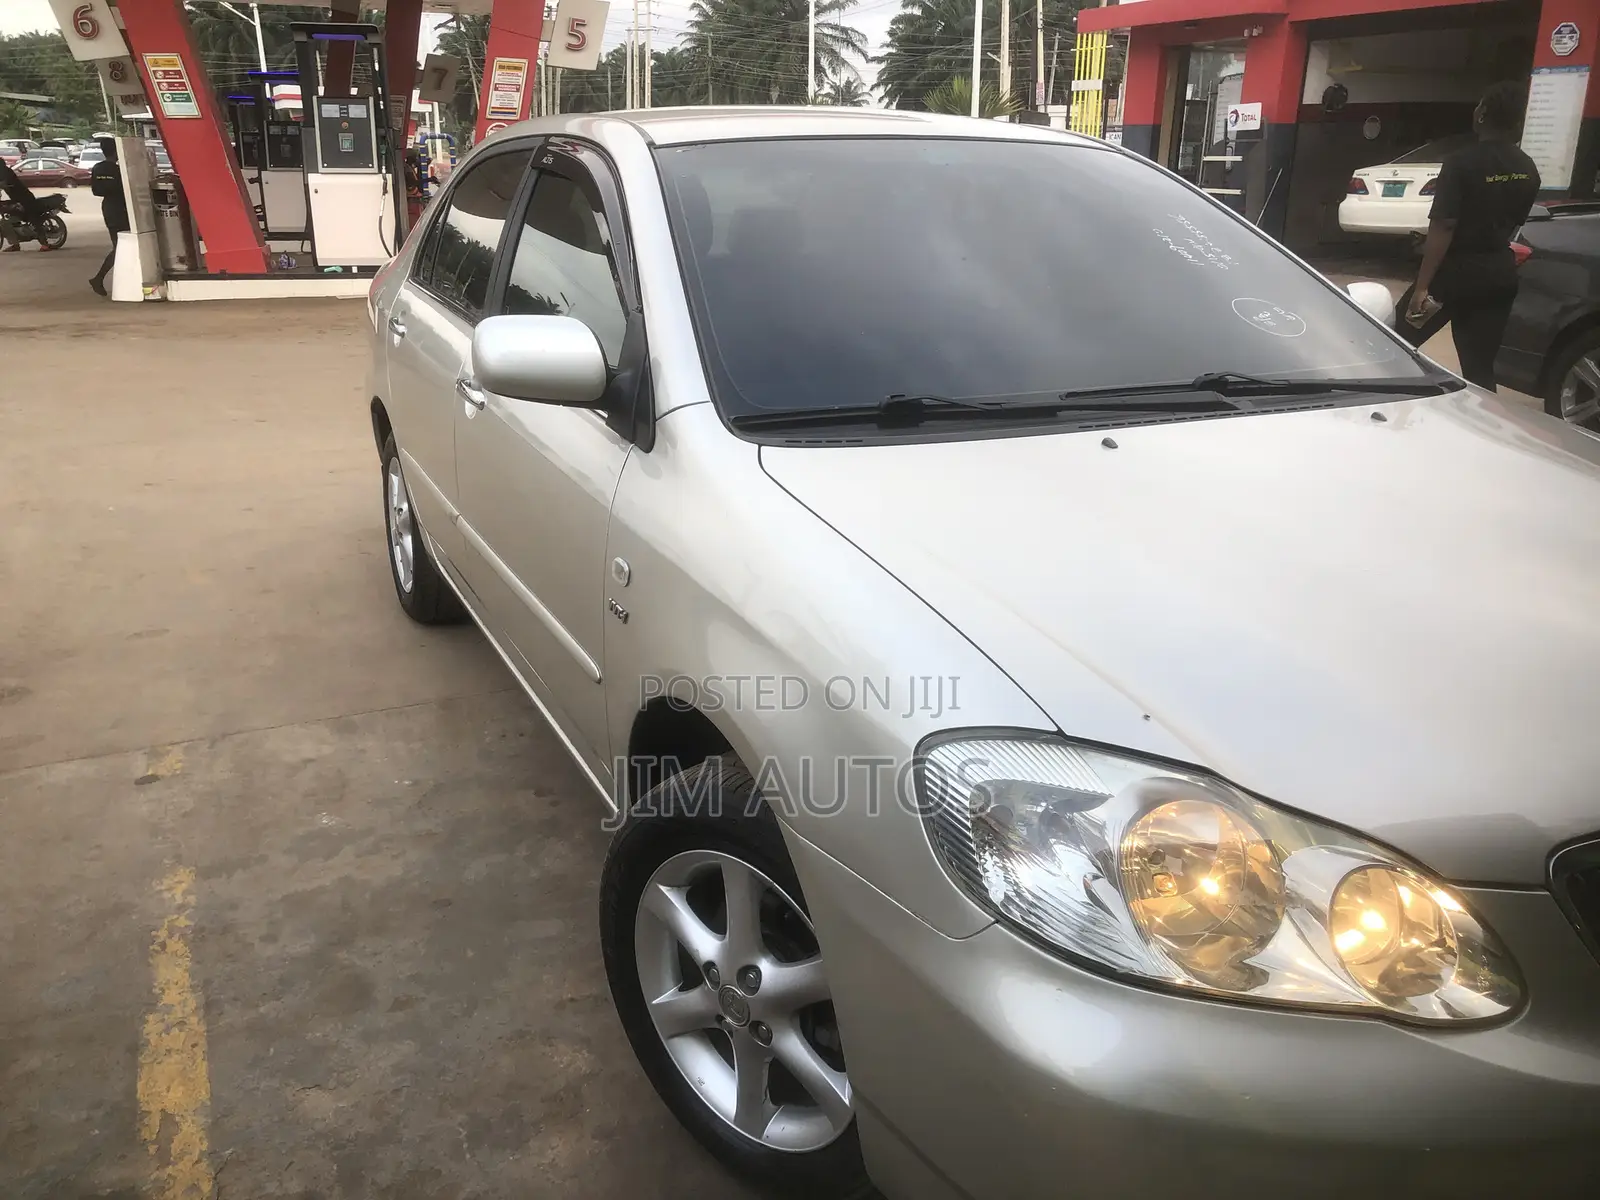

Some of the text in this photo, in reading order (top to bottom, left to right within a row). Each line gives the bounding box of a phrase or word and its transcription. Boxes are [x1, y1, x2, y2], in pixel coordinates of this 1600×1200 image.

[73, 3, 99, 39] 6
[566, 17, 588, 51] 5
[109, 61, 124, 81] 8
[432, 68, 448, 90] 7
